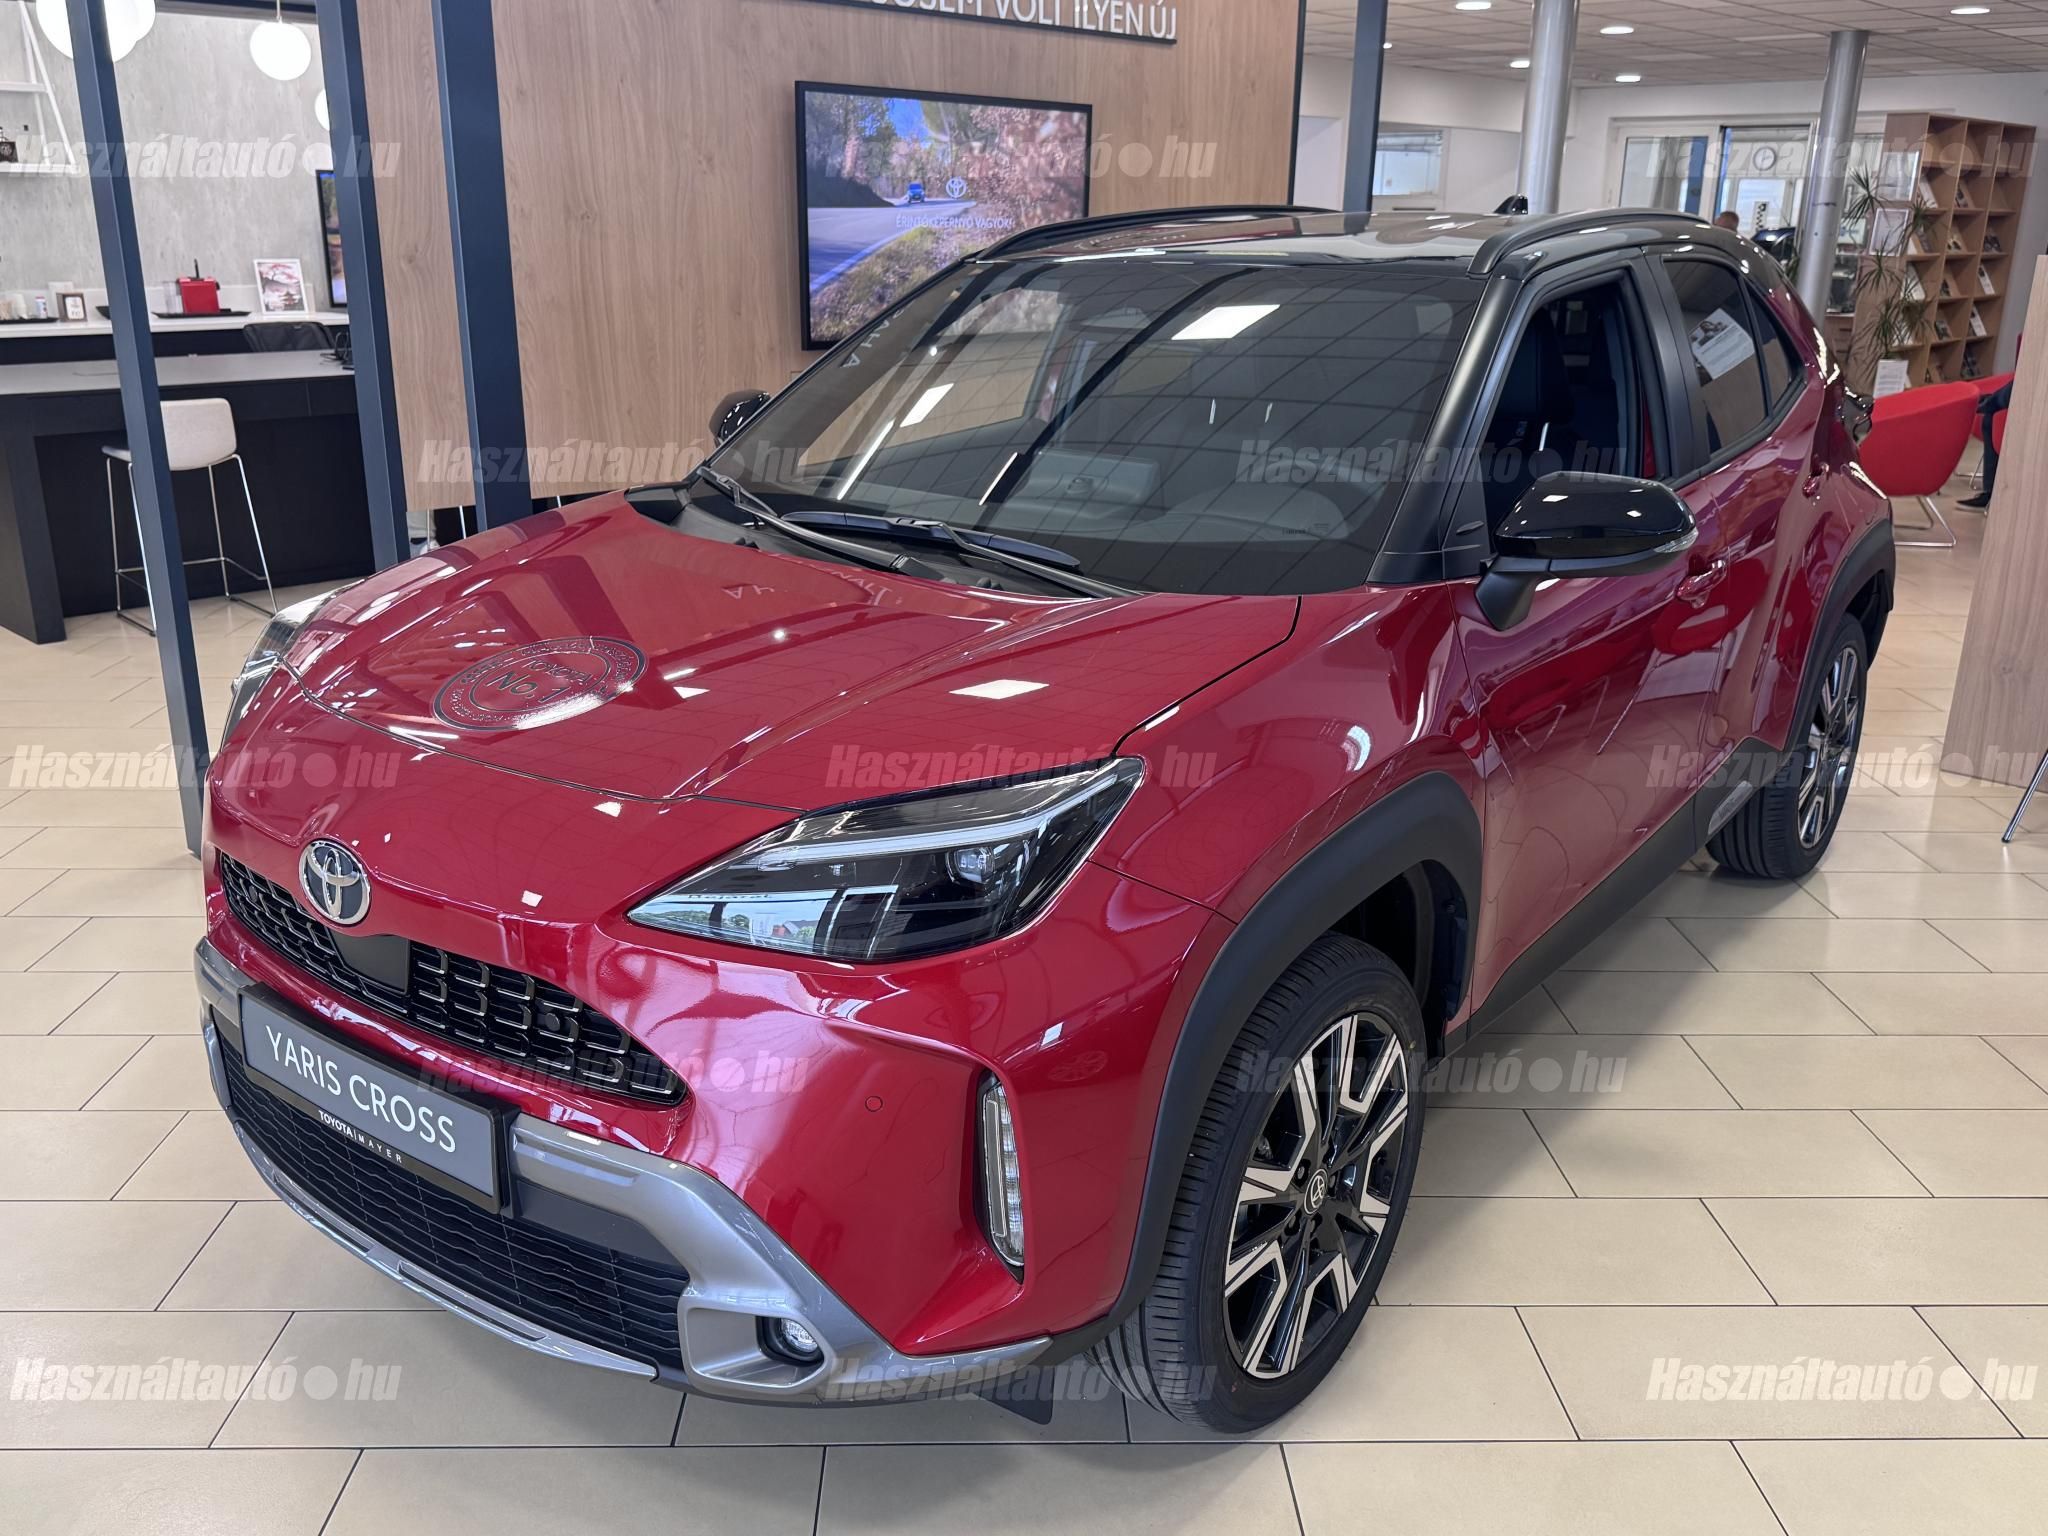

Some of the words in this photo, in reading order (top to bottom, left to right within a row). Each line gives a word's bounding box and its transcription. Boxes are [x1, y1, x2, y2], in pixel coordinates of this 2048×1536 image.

[1074, 0, 1143, 36] ILYEN
[1149, 0, 1177, 39] ÚJ
[265, 1025, 341, 1096] YARIS
[349, 1074, 456, 1153] CROSS
